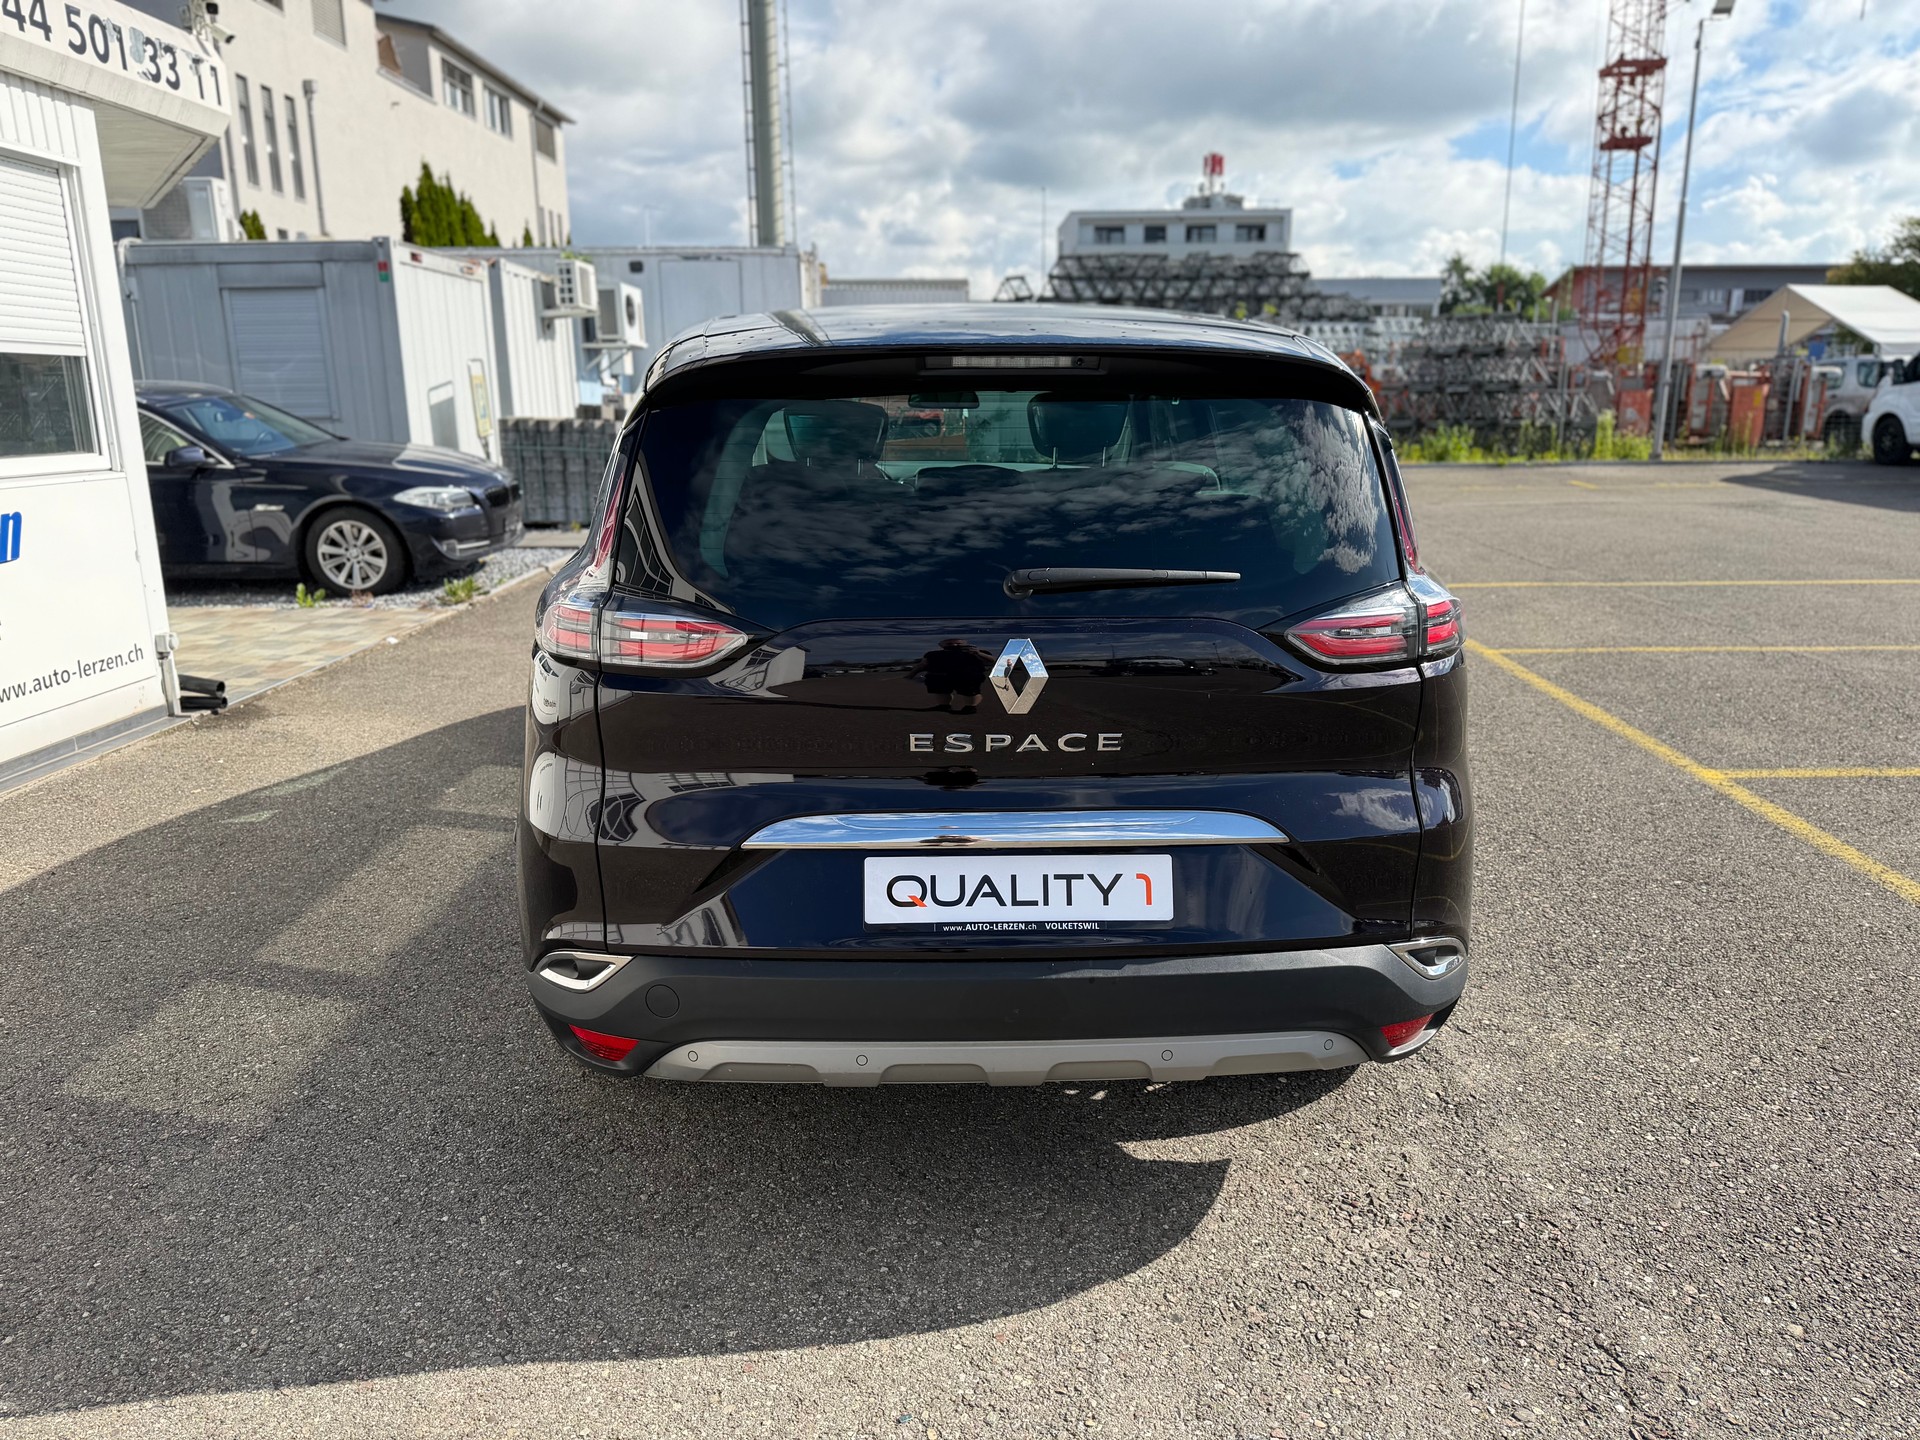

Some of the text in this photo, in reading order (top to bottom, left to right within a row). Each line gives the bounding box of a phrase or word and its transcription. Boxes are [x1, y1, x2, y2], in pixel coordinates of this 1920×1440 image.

[64, 3, 128, 71] 501
[909, 733, 1123, 753] ESPACE
[942, 922, 1100, 932] www.AUTO-LERZEN.ch VOLKETSWIL
